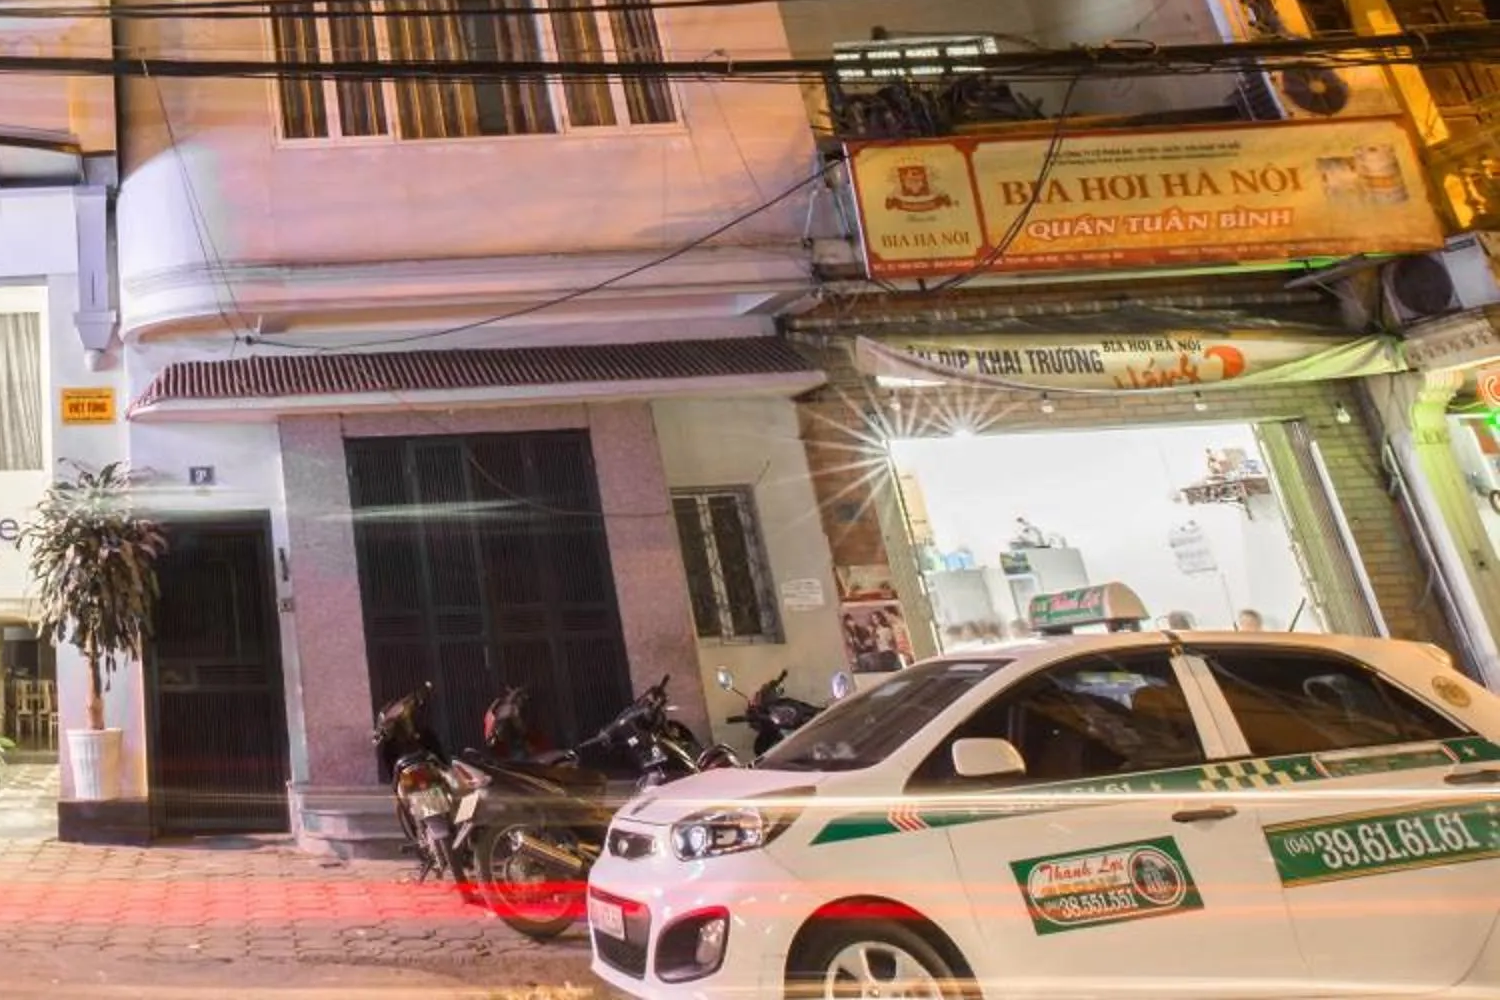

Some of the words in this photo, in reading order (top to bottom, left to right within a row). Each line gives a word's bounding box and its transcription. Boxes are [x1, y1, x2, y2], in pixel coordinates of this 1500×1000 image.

[1000, 178, 1071, 206] BIA
[1229, 162, 1306, 198] NỘI
[881, 234, 910, 248] BIA
[1026, 213, 1116, 242] QUÁN
[1218, 204, 1293, 229] BÌNH
[975, 349, 1023, 375] KHAI
[1314, 812, 1480, 869] 39.61.61.61
